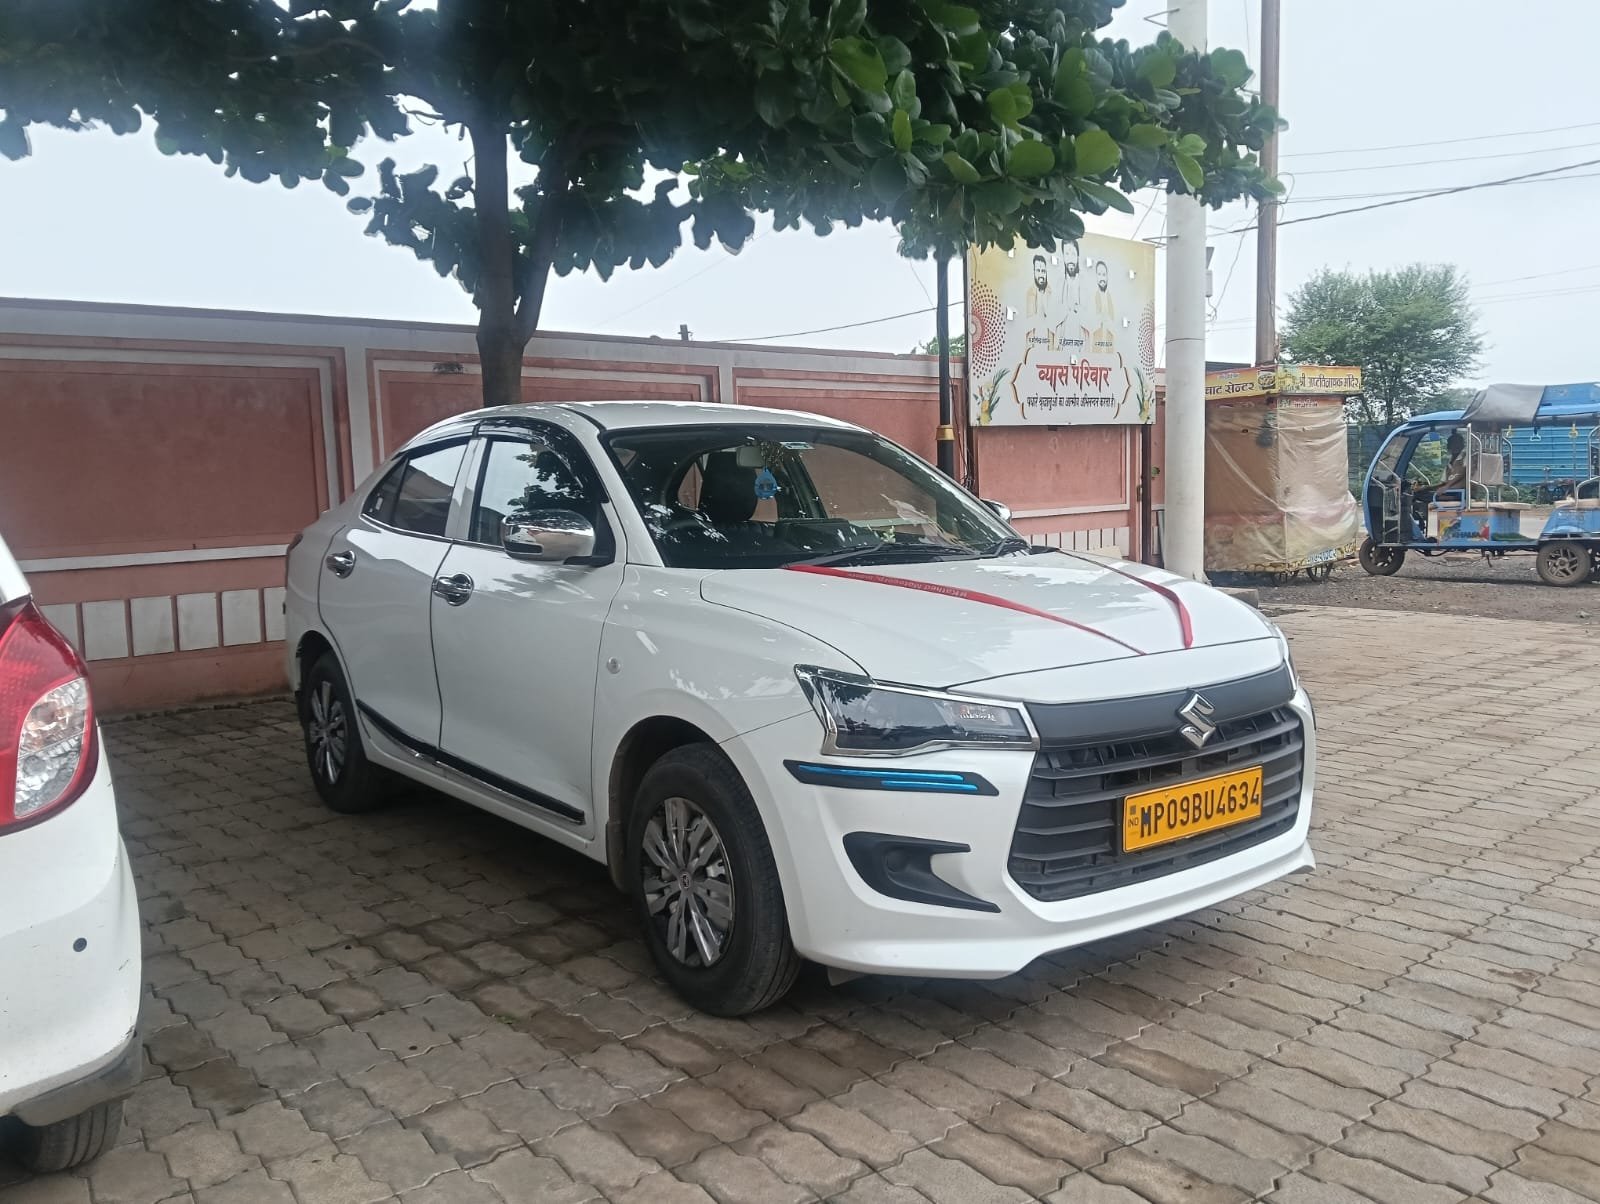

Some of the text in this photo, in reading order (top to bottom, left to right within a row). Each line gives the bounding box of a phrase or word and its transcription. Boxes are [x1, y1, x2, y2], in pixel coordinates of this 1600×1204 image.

[1036, 359, 1112, 392] व्यास परिवार
[1128, 817, 1139, 828] IND
[1140, 777, 1260, 838] MP09BU4634
